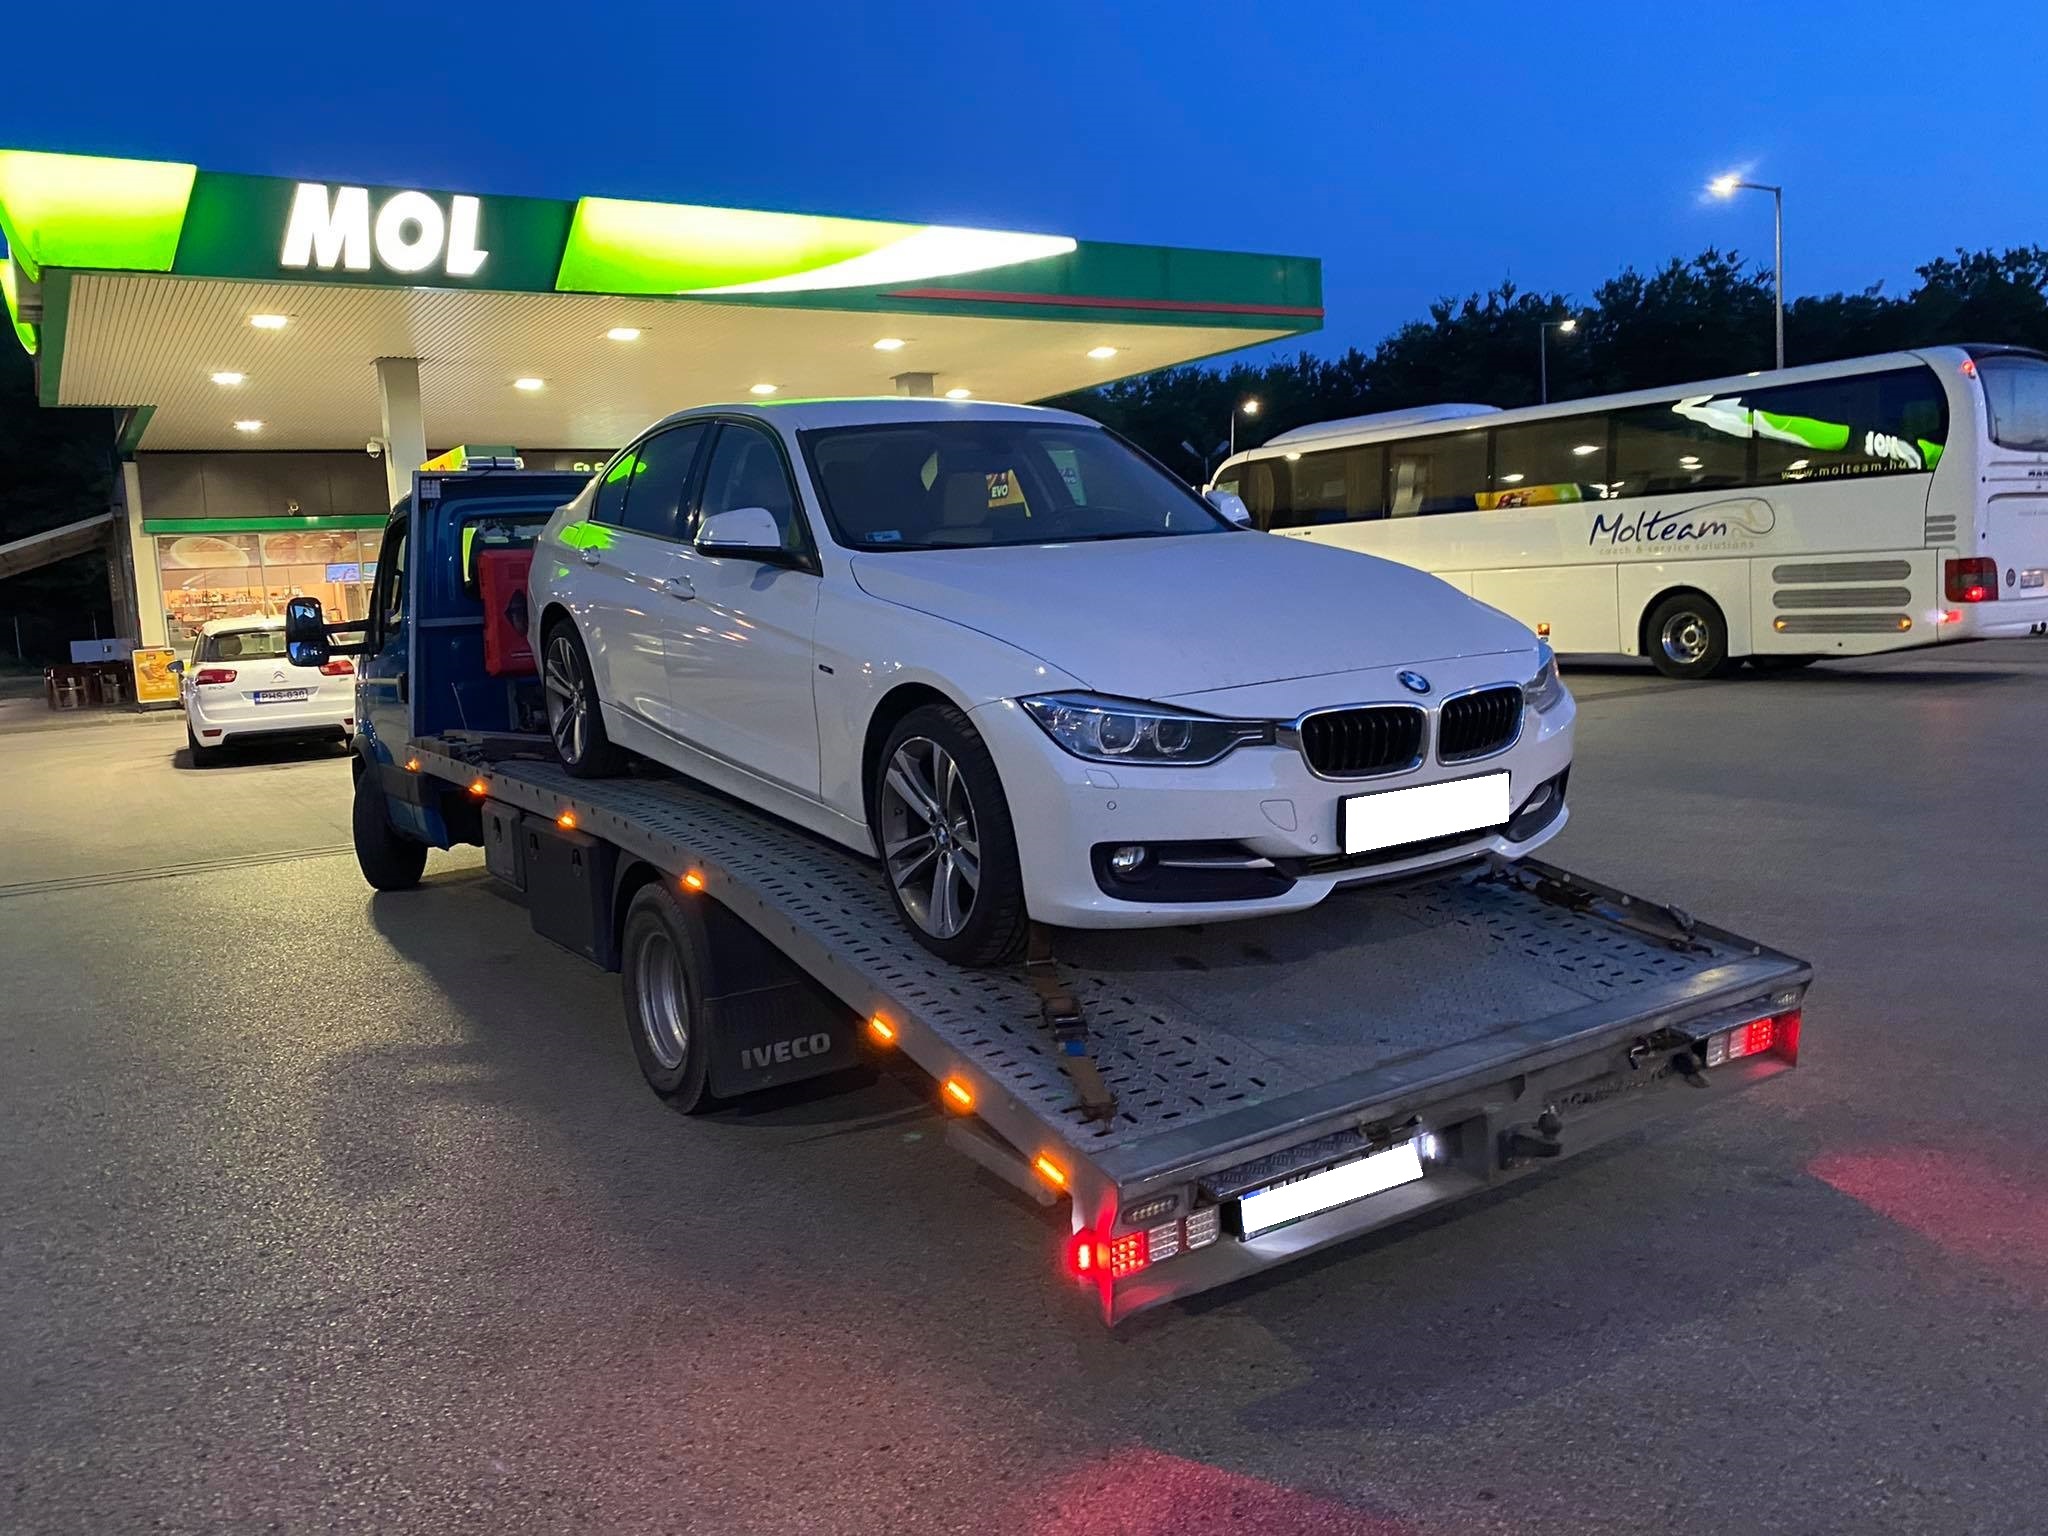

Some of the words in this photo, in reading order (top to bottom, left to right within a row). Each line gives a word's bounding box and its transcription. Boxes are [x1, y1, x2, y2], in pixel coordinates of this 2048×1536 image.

[281, 182, 489, 275] MOL
[991, 484, 1009, 498] EVO
[1589, 510, 1727, 546] Molteam
[1647, 544, 1690, 553] service
[1695, 541, 1755, 550] solutions
[742, 1033, 831, 1070] IVECO
